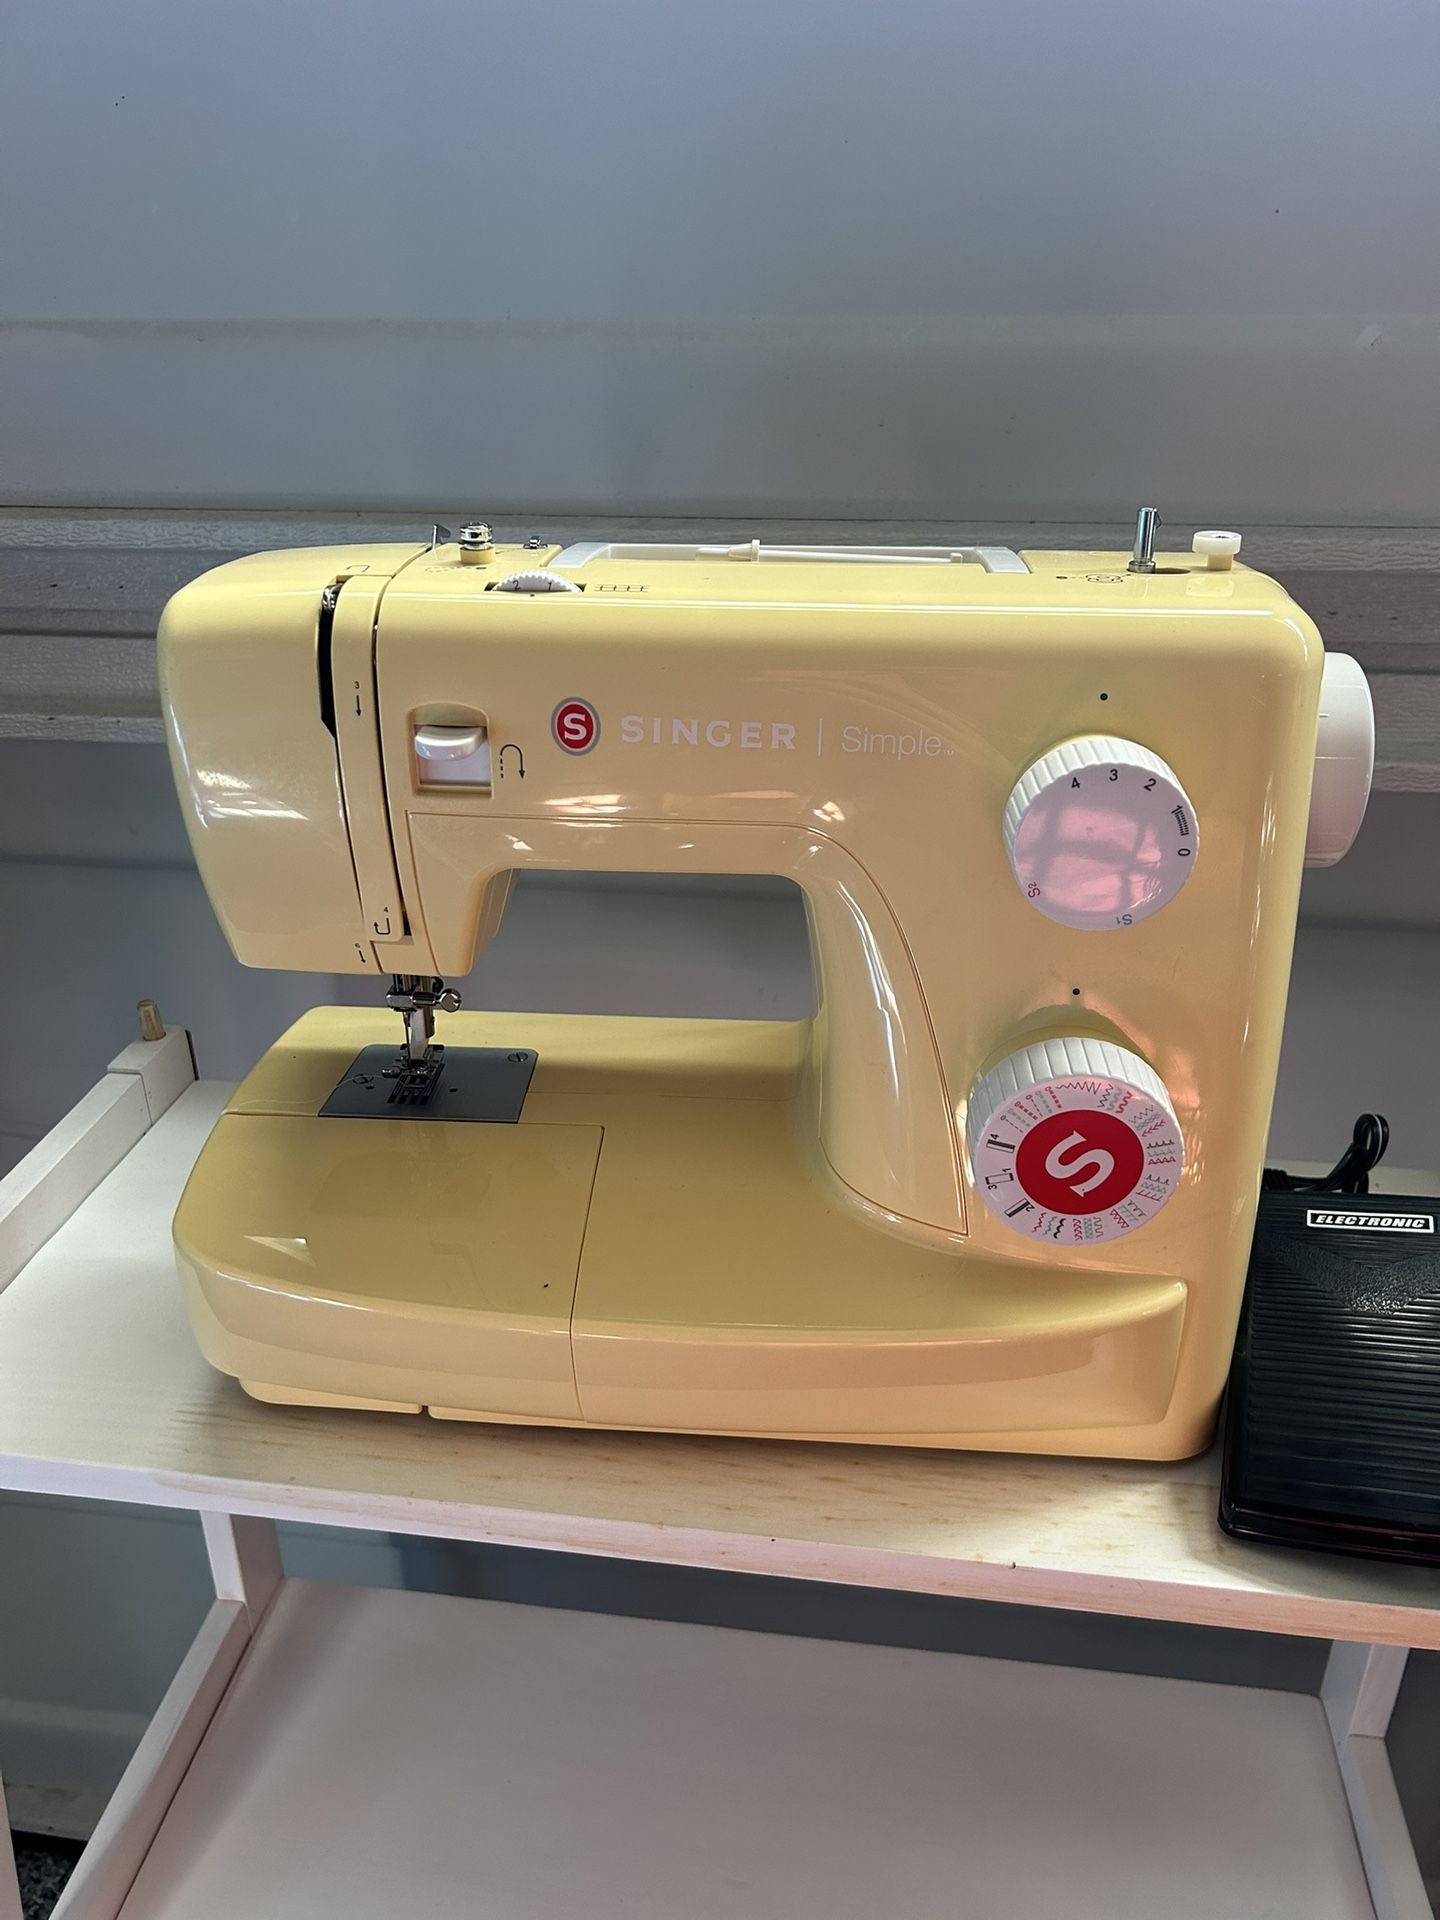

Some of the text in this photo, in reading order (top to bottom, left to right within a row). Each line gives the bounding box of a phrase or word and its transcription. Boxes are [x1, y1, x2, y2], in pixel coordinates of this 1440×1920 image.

[512, 579, 553, 591] 2 1
[354, 680, 360, 690] 3
[563, 712, 587, 742] S
[620, 714, 797, 751] SINGER
[1109, 769, 1118, 781] 3
[1071, 777, 1080, 789] 4
[1144, 778, 1156, 791] 2
[1170, 804, 1183, 814] 1
[1177, 848, 1191, 857] 0
[1116, 913, 1133, 926] S1
[1025, 1203, 1035, 1212] 2
[1315, 1215, 1425, 1228] ELECTRONIC
